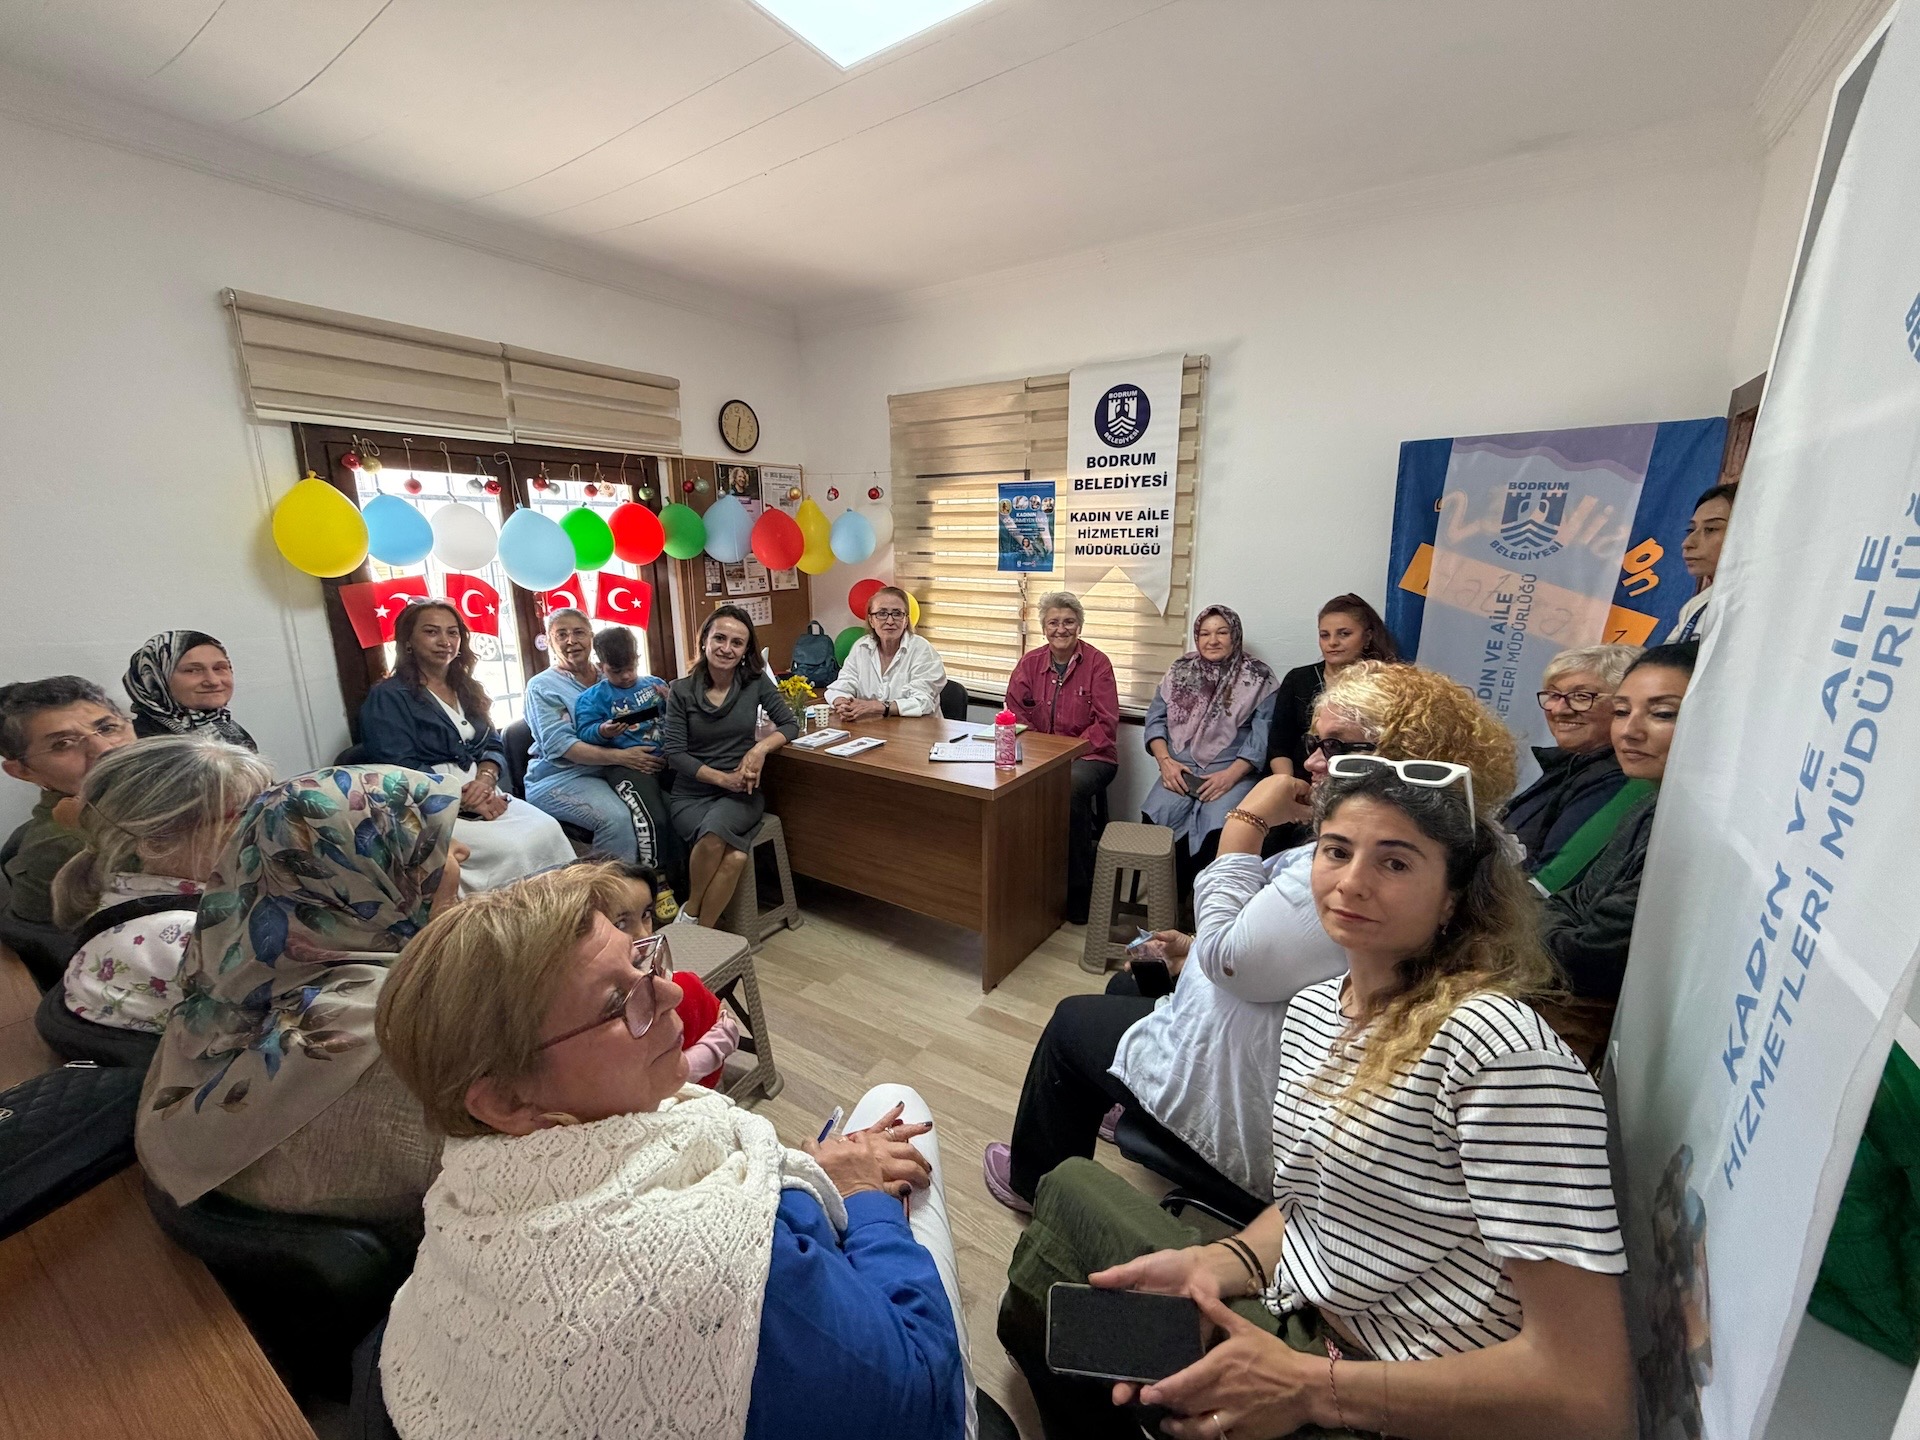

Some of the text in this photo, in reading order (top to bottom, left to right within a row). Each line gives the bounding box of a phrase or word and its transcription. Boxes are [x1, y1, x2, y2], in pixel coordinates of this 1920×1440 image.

[1108, 390, 1138, 399] BODRUM
[1103, 428, 1140, 444] BELEDİYESİ
[1086, 452, 1156, 469] BODRUM
[1074, 471, 1168, 491] BELEDİYESİ
[1508, 481, 1570, 491] BODRUM
[1070, 507, 1169, 523] KADIN VE AİLE
[1078, 525, 1159, 539] HİZMETLERİ
[1075, 542, 1160, 556] MÜDÜRLÜĞÜ
[1489, 540, 1564, 561] BELEDİYESİ
[1477, 593, 1513, 704] DIN VE AİLE
[1496, 573, 1537, 718] ETLERİ MÜDÜRLÜĞÜ
[1820, 492, 1920, 860] MÜDÜRLÜ
[1722, 535, 1891, 1085] KADIN VE AİLE
